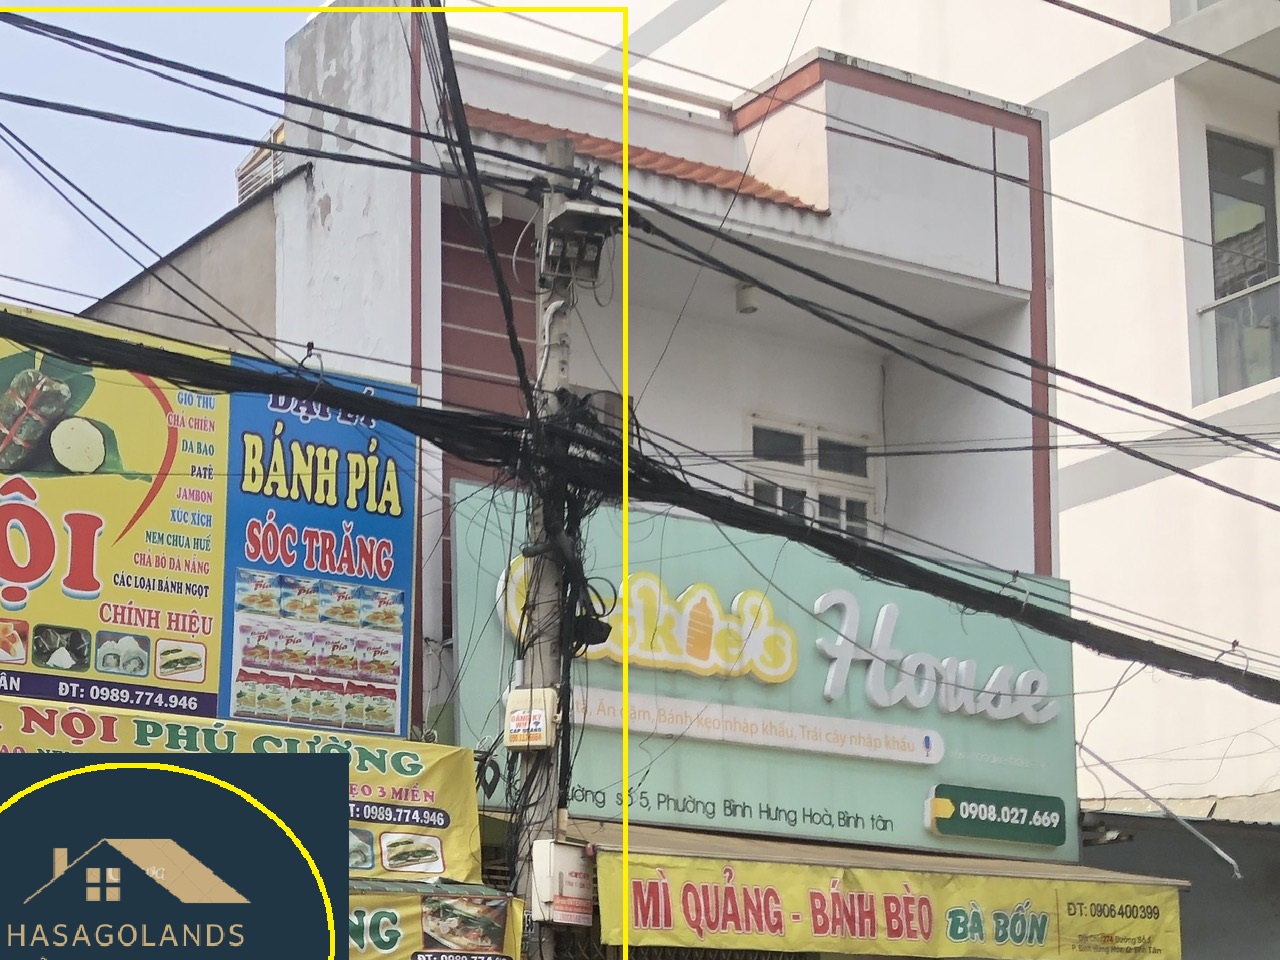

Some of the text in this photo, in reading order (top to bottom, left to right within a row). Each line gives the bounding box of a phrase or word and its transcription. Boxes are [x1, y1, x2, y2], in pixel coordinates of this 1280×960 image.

[181, 439, 215, 457] DA BAO
[241, 418, 404, 518] BÁNH PÍA
[176, 487, 213, 504] JAMBON
[170, 507, 213, 528] XÚC XÍCH
[145, 530, 212, 552] NEM CHUA HUẾ
[245, 508, 395, 581] SÓC TRĂNG
[113, 570, 210, 600] CÁC LOẠI BÁNH NGỌT
[99, 600, 214, 639] CHÍNH HIỆU
[813, 588, 1059, 726] House
[58, 681, 85, 699] ĐT:
[89, 685, 198, 711] 0989.774.946
[19, 705, 119, 746] NỘI
[132, 721, 238, 754] PHÚ
[657, 707, 693, 726] Bánh
[695, 712, 721, 731] kẹo
[377, 786, 387, 798] 3
[349, 803, 445, 826] T: 0989.774.946
[567, 784, 606, 809] ường
[657, 793, 716, 820] Phường
[723, 799, 753, 819] Bình
[759, 803, 798, 827] Hưng
[802, 807, 836, 828] Hoà,
[837, 809, 865, 830] Bình
[870, 812, 894, 832] tân
[958, 800, 1061, 829] 0908.027.669
[631, 867, 674, 930] MÌ
[681, 865, 785, 941] QUẢNG
[808, 878, 877, 939] BÁNH
[883, 883, 935, 944] BÈO
[946, 900, 986, 944] BÀ
[992, 898, 1050, 947] BỐN
[1067, 902, 1088, 917] ĐT:
